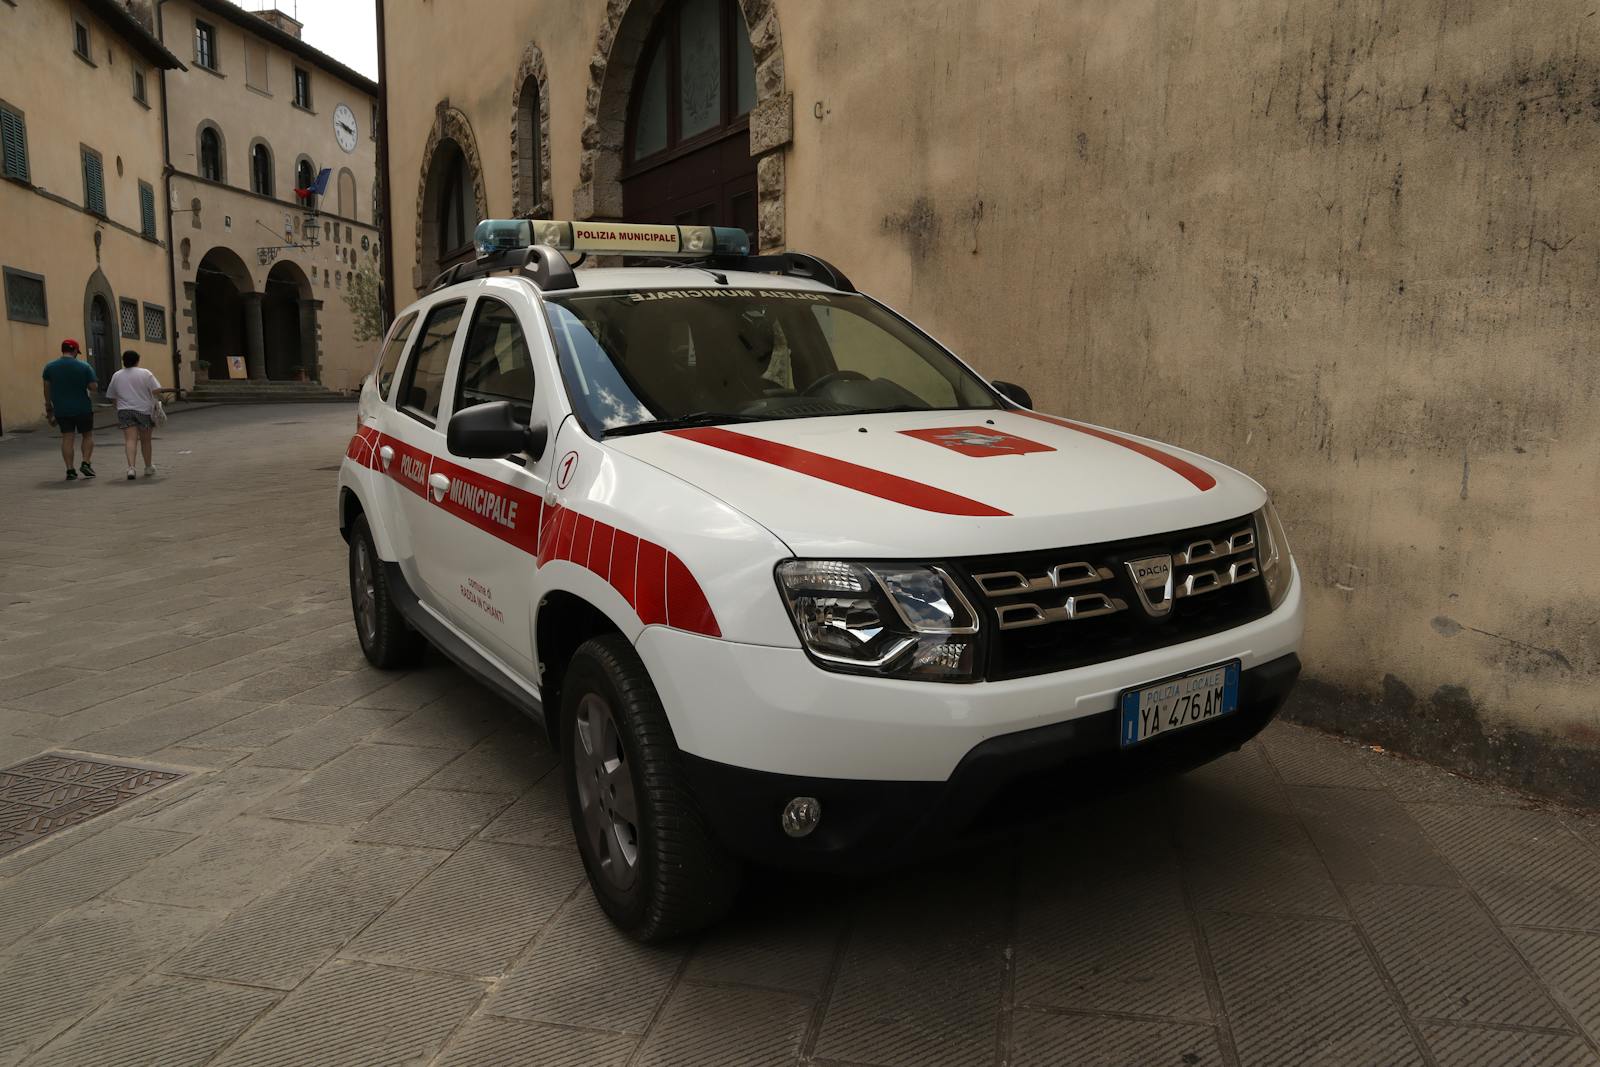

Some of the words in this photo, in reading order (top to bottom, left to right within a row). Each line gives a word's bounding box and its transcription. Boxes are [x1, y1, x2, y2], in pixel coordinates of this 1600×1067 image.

[577, 230, 617, 241] POLIZIA
[618, 232, 676, 243] MUNICIPALE
[562, 456, 574, 484] 1
[400, 454, 427, 486] POLIZIA
[450, 477, 519, 529] MUNICIPALE
[1138, 564, 1169, 577] DACIA
[1147, 684, 1180, 706] POLIZIA
[1186, 673, 1221, 693] LOCALE
